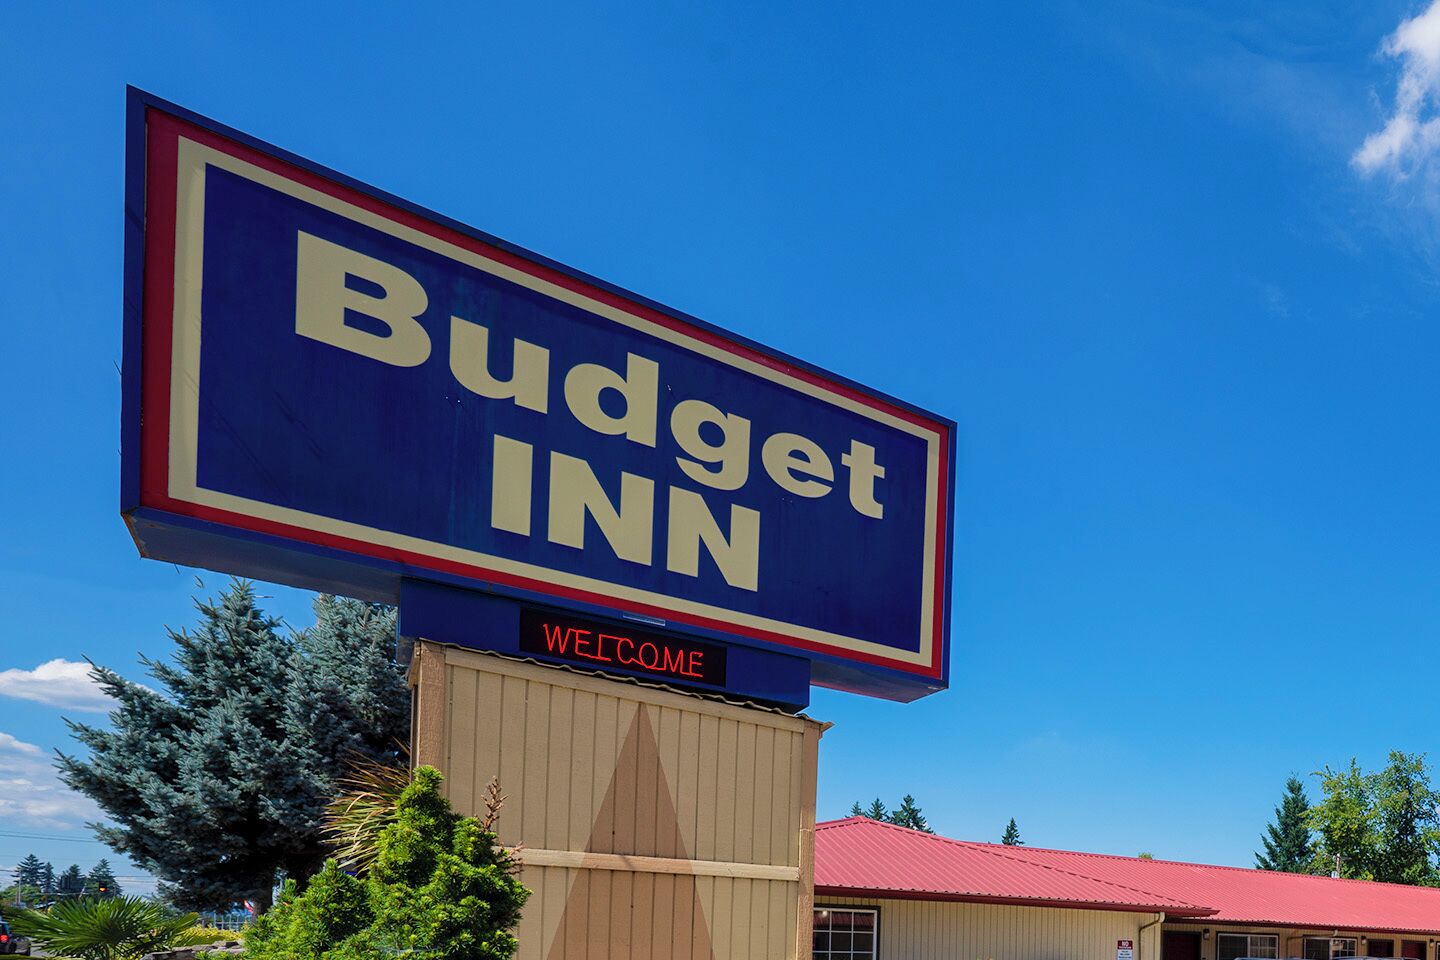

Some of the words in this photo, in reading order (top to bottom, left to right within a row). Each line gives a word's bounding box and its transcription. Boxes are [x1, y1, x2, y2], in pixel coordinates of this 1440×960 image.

[295, 230, 884, 520] Budget
[491, 434, 760, 593] INN
[543, 623, 703, 677] WELCOME
